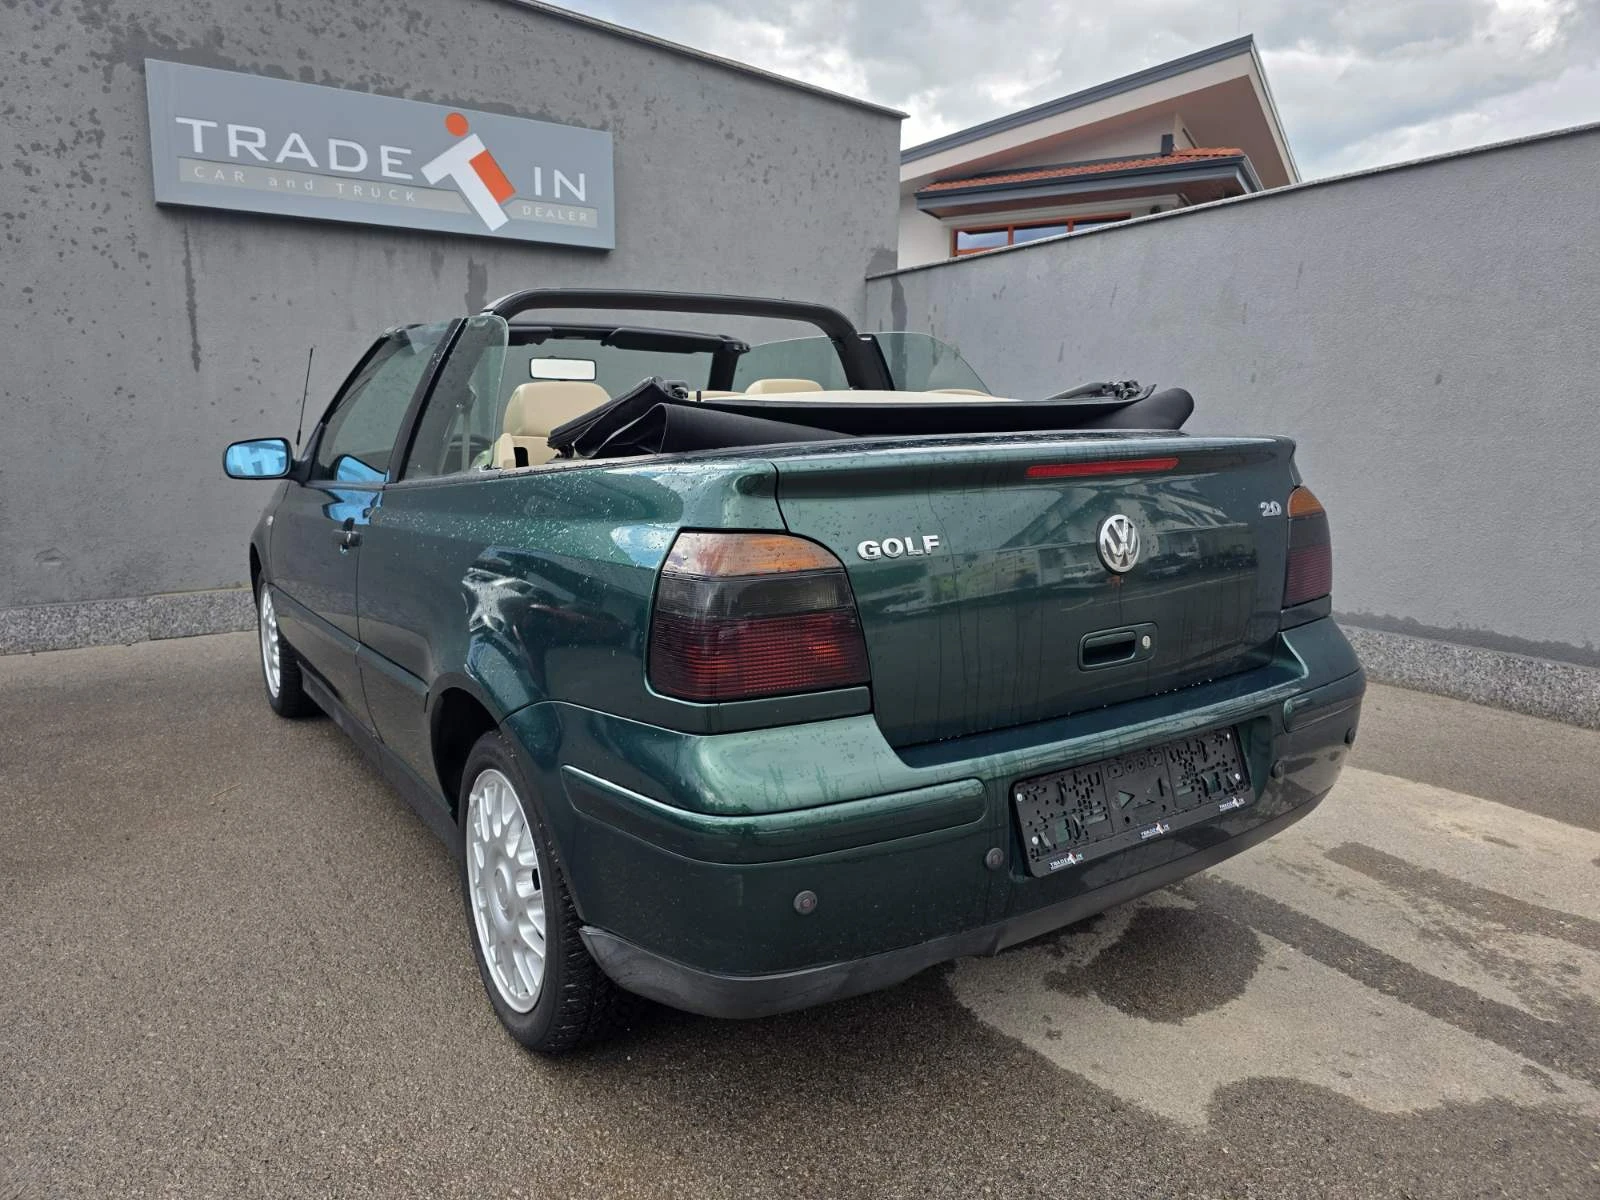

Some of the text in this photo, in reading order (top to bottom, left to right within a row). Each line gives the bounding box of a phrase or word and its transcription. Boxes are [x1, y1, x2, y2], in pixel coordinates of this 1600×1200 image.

[175, 117, 413, 179] TRADE
[534, 166, 586, 202] IN
[194, 166, 587, 222] CAR and TRUCK DEALER
[857, 534, 940, 560] GOLF
